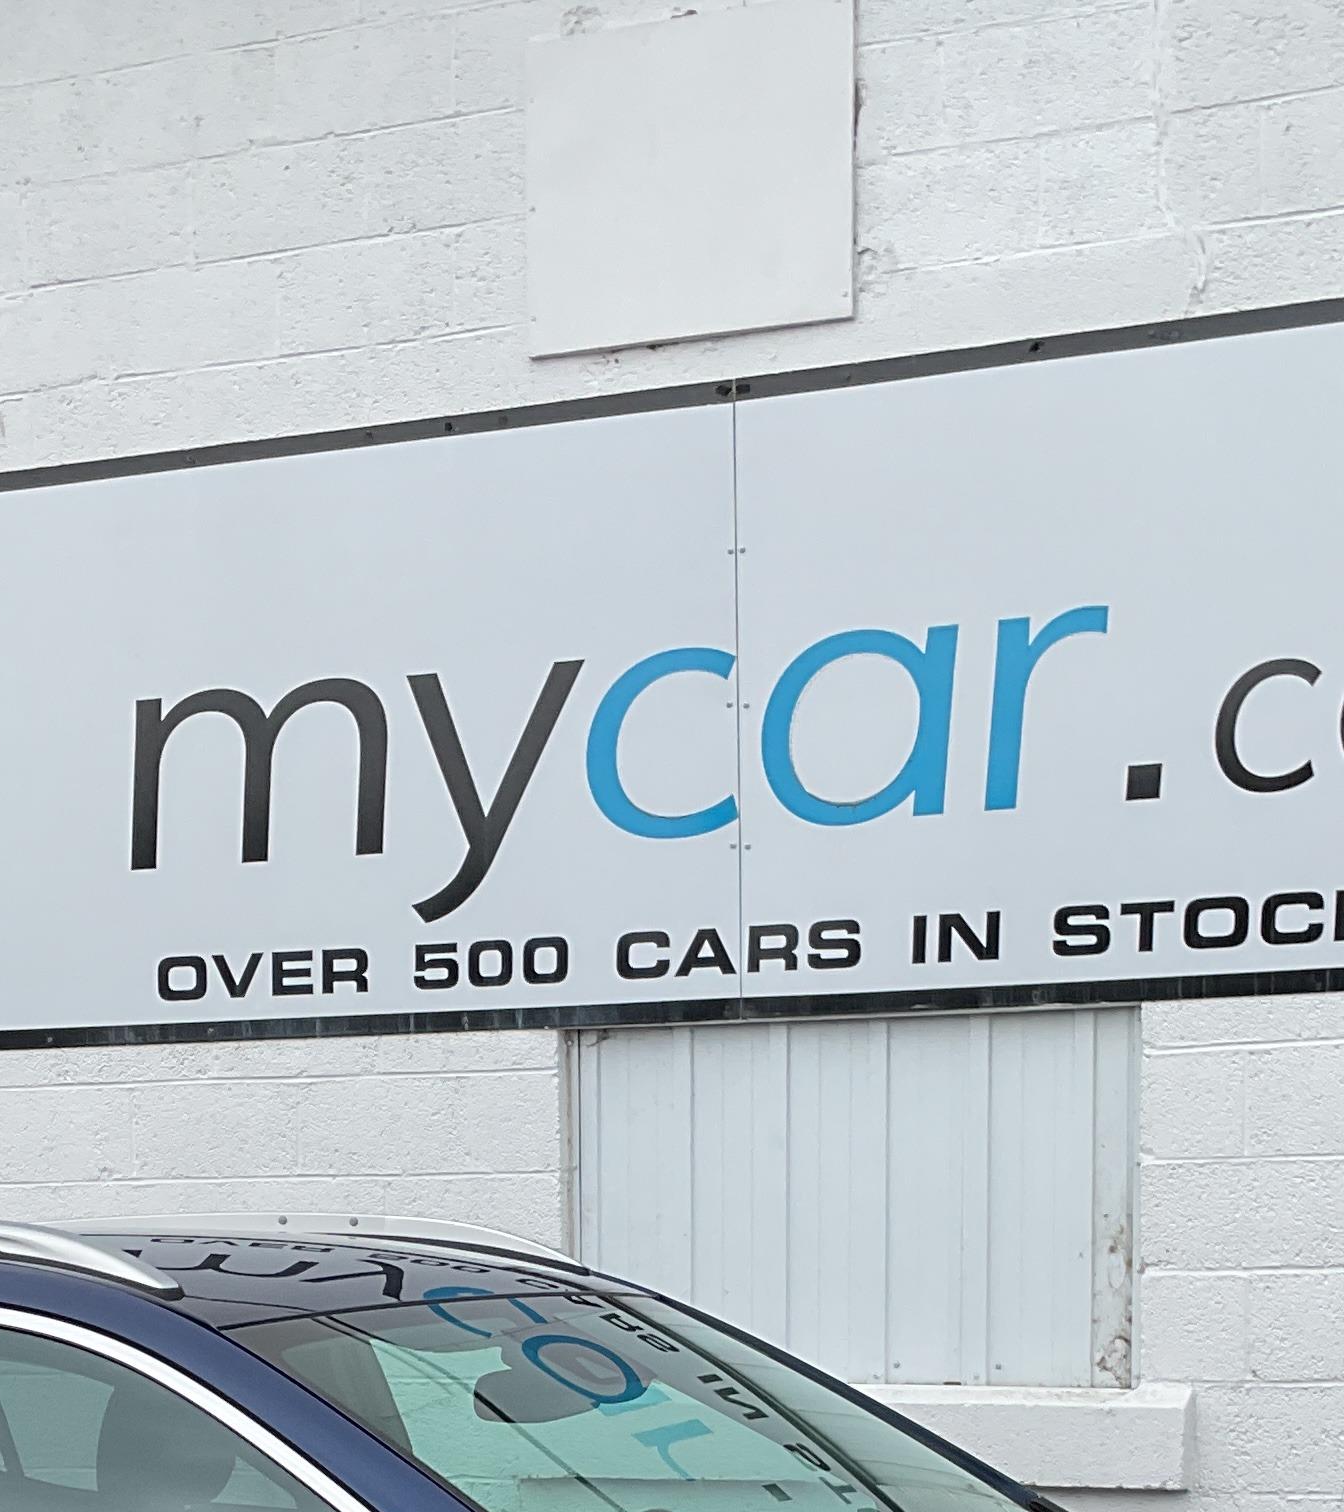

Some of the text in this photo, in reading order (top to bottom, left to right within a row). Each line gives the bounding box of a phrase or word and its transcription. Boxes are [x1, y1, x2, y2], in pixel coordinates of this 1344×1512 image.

[157, 948, 369, 1002] OVER
[413, 936, 569, 990] 500
[616, 919, 862, 980] CARS
[911, 910, 1001, 965] IN
